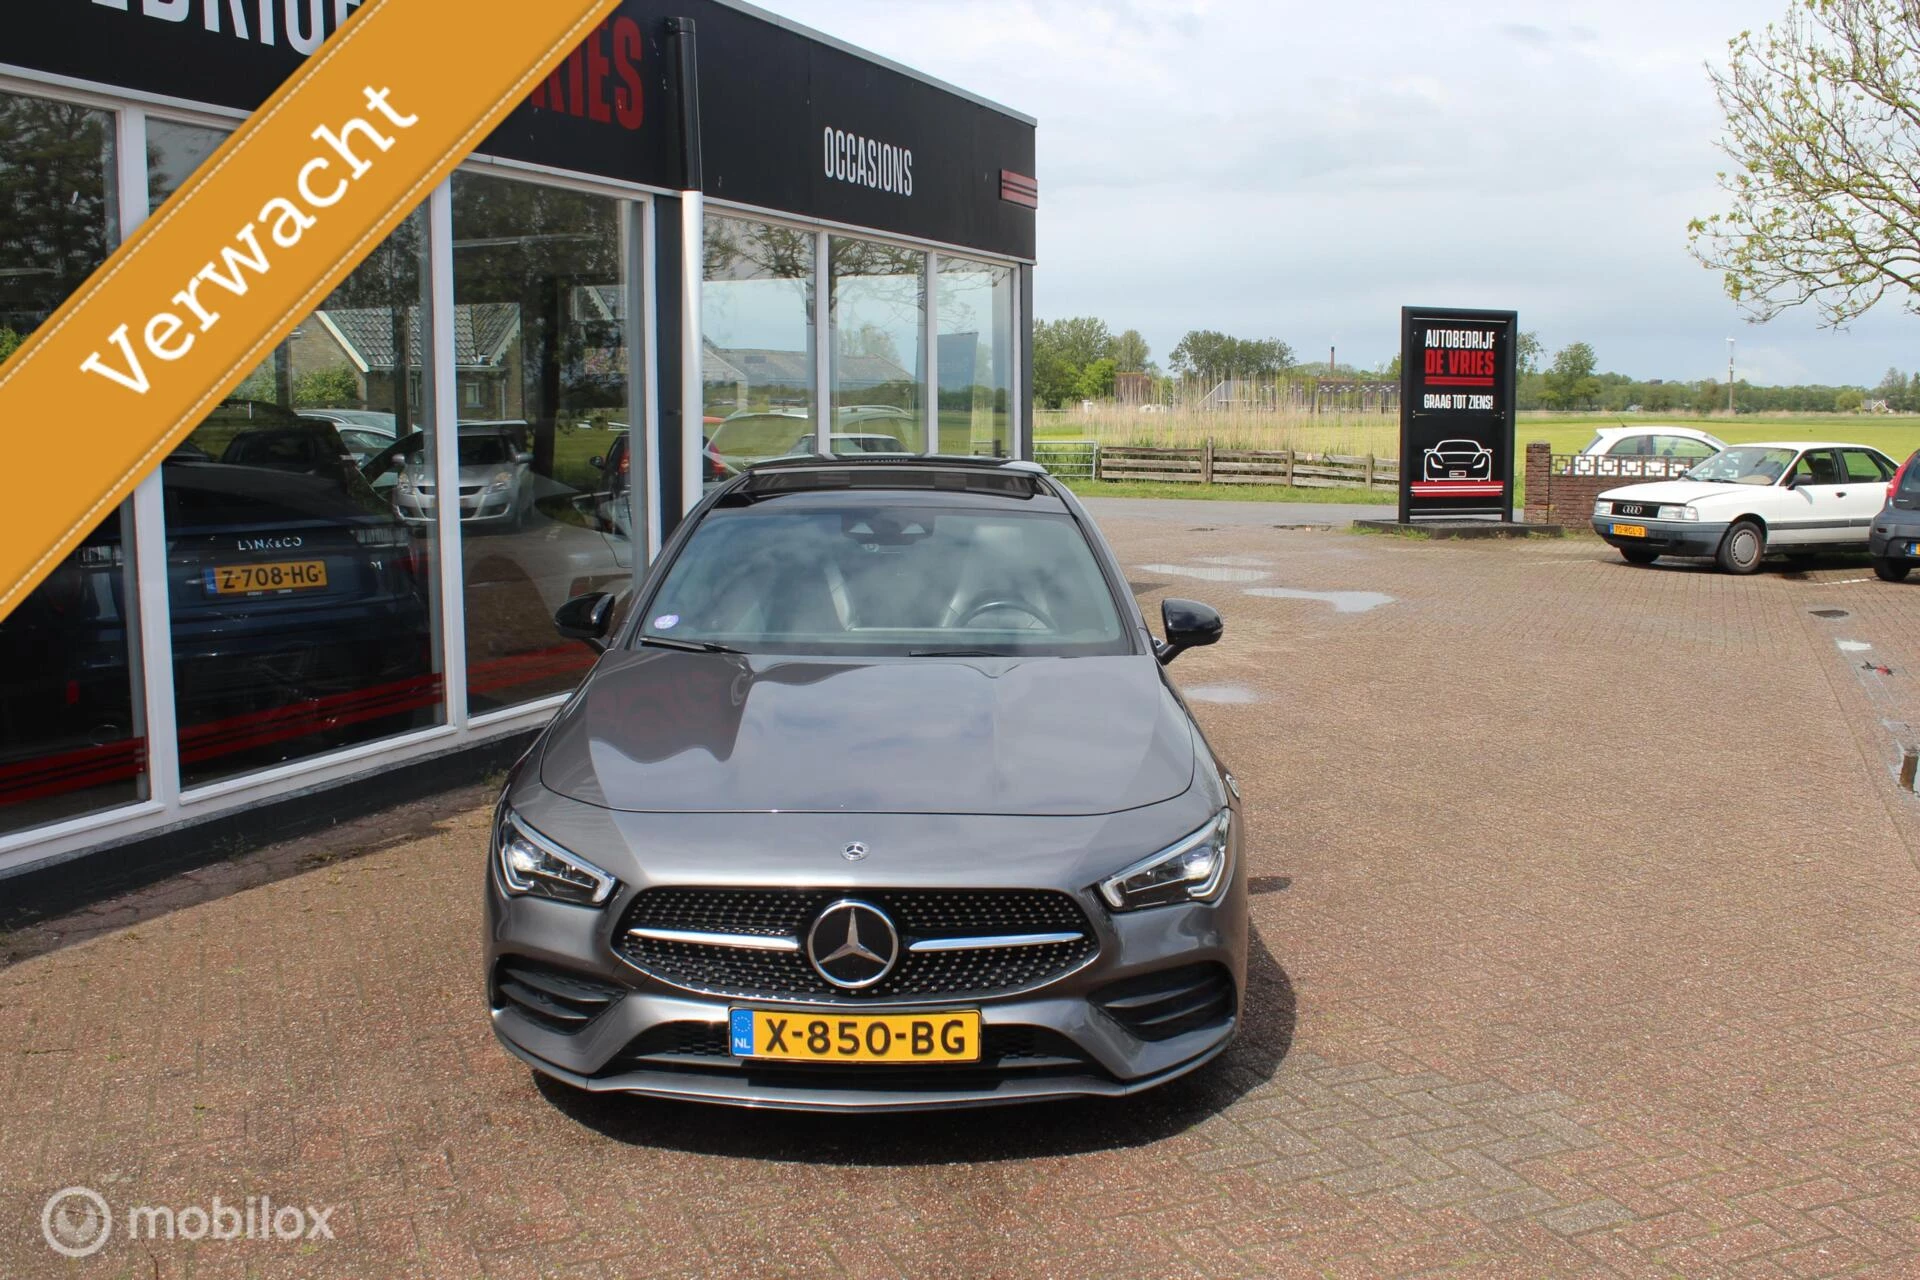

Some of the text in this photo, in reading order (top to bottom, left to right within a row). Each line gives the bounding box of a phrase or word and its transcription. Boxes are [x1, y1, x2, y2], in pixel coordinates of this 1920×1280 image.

[824, 126, 913, 197] OCCASIONS
[1425, 329, 1495, 349] AUTOBEDRIJF
[1425, 349, 1495, 376] DE VRIES
[1424, 394, 1493, 410] GRAAG TOT ZIENS!
[222, 565, 319, 590] Z-708-HG
[734, 1037, 750, 1049] NL
[765, 1018, 965, 1056] X-850-BG
